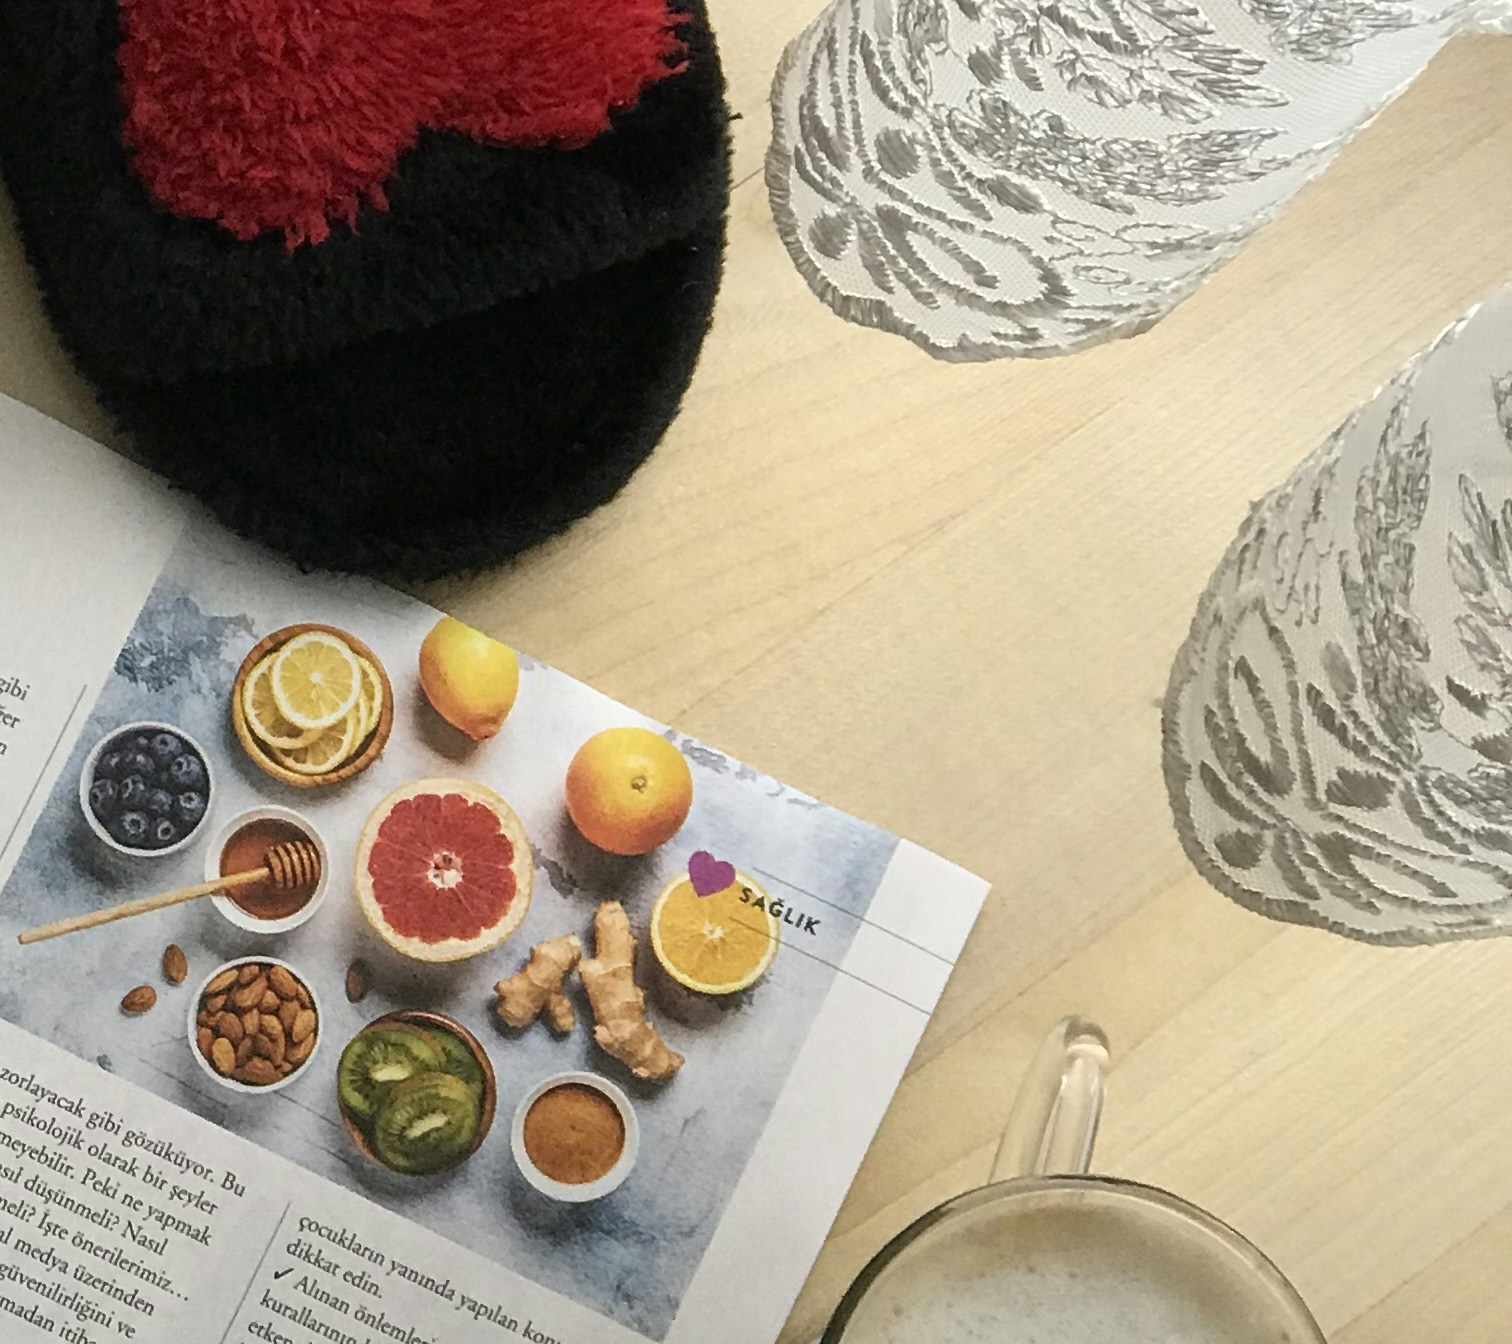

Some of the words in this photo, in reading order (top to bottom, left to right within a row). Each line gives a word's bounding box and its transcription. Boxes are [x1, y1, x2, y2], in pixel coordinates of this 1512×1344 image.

[737, 885, 823, 936] SAĞLIK
[0, 1101, 85, 1151] psikolojik
[87, 1142, 140, 1178] olarak
[141, 1164, 168, 1191] bir
[168, 1185, 219, 1216] şeyler
[85, 1110, 124, 1136] gibi
[121, 1130, 214, 1183] gözüküyor.
[220, 1170, 246, 1198] Bu
[13, 1238, 69, 1275] medya
[72, 1264, 155, 1317] üzerinden
[298, 1216, 386, 1267] çocukların
[385, 1259, 456, 1302] yanında
[454, 1294, 519, 1333] yapılan
